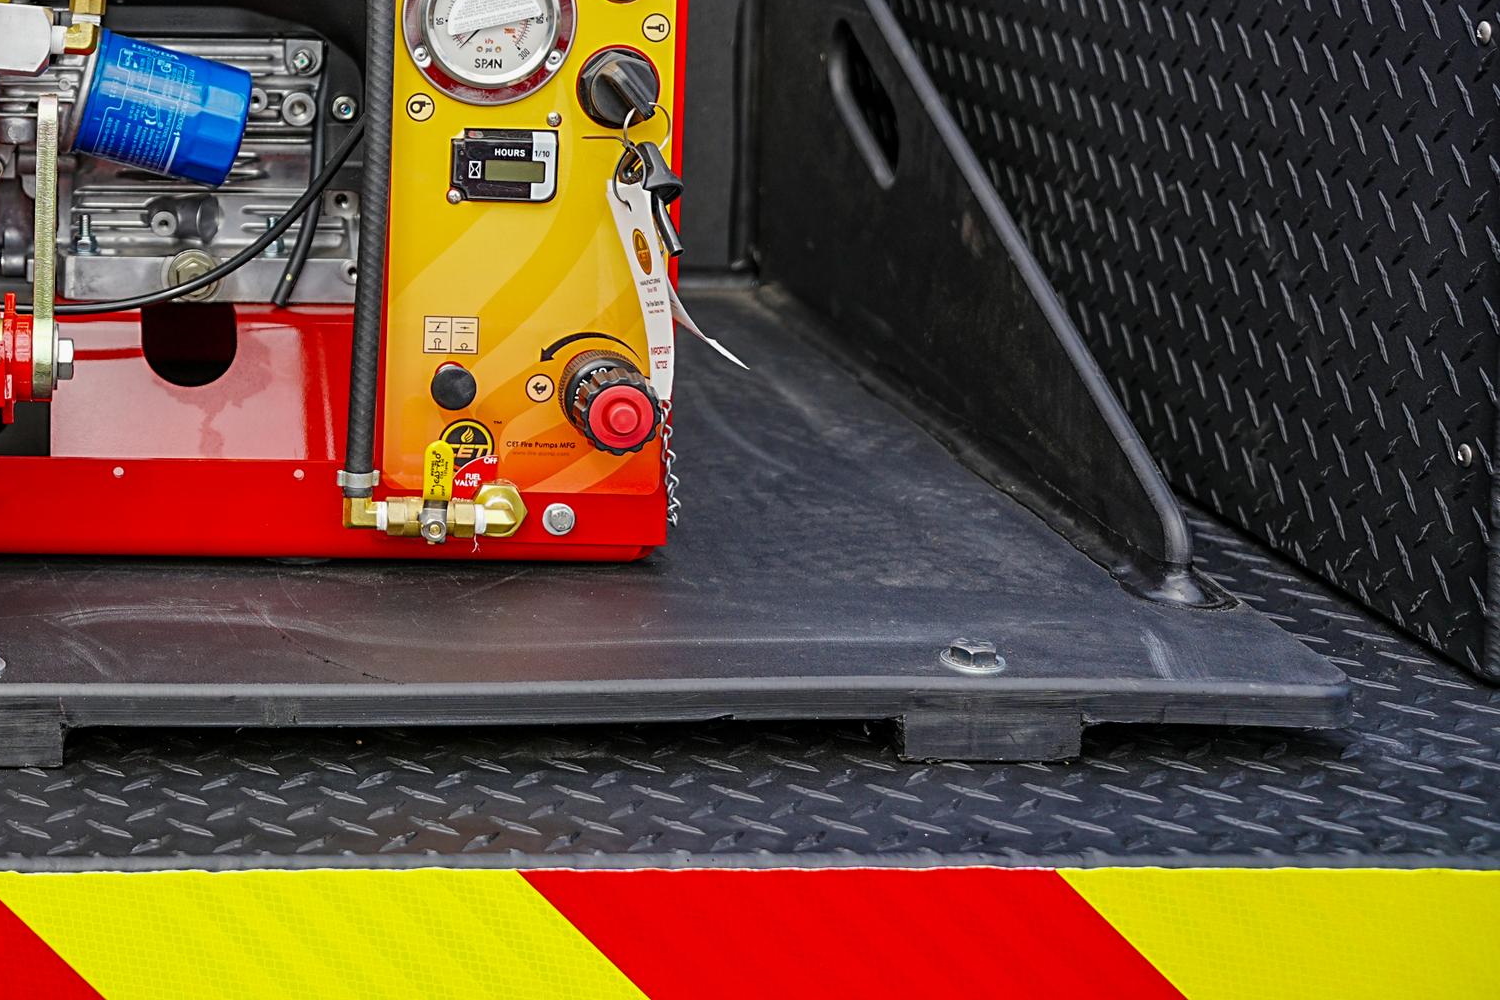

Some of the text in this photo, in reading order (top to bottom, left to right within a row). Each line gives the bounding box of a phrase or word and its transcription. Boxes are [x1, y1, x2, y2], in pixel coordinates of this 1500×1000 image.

[436, 17, 444, 26] 50
[132, 43, 179, 61] HONDA
[518, 48, 531, 60] 300
[474, 59, 503, 69] SPAN
[494, 148, 526, 157] HOURS
